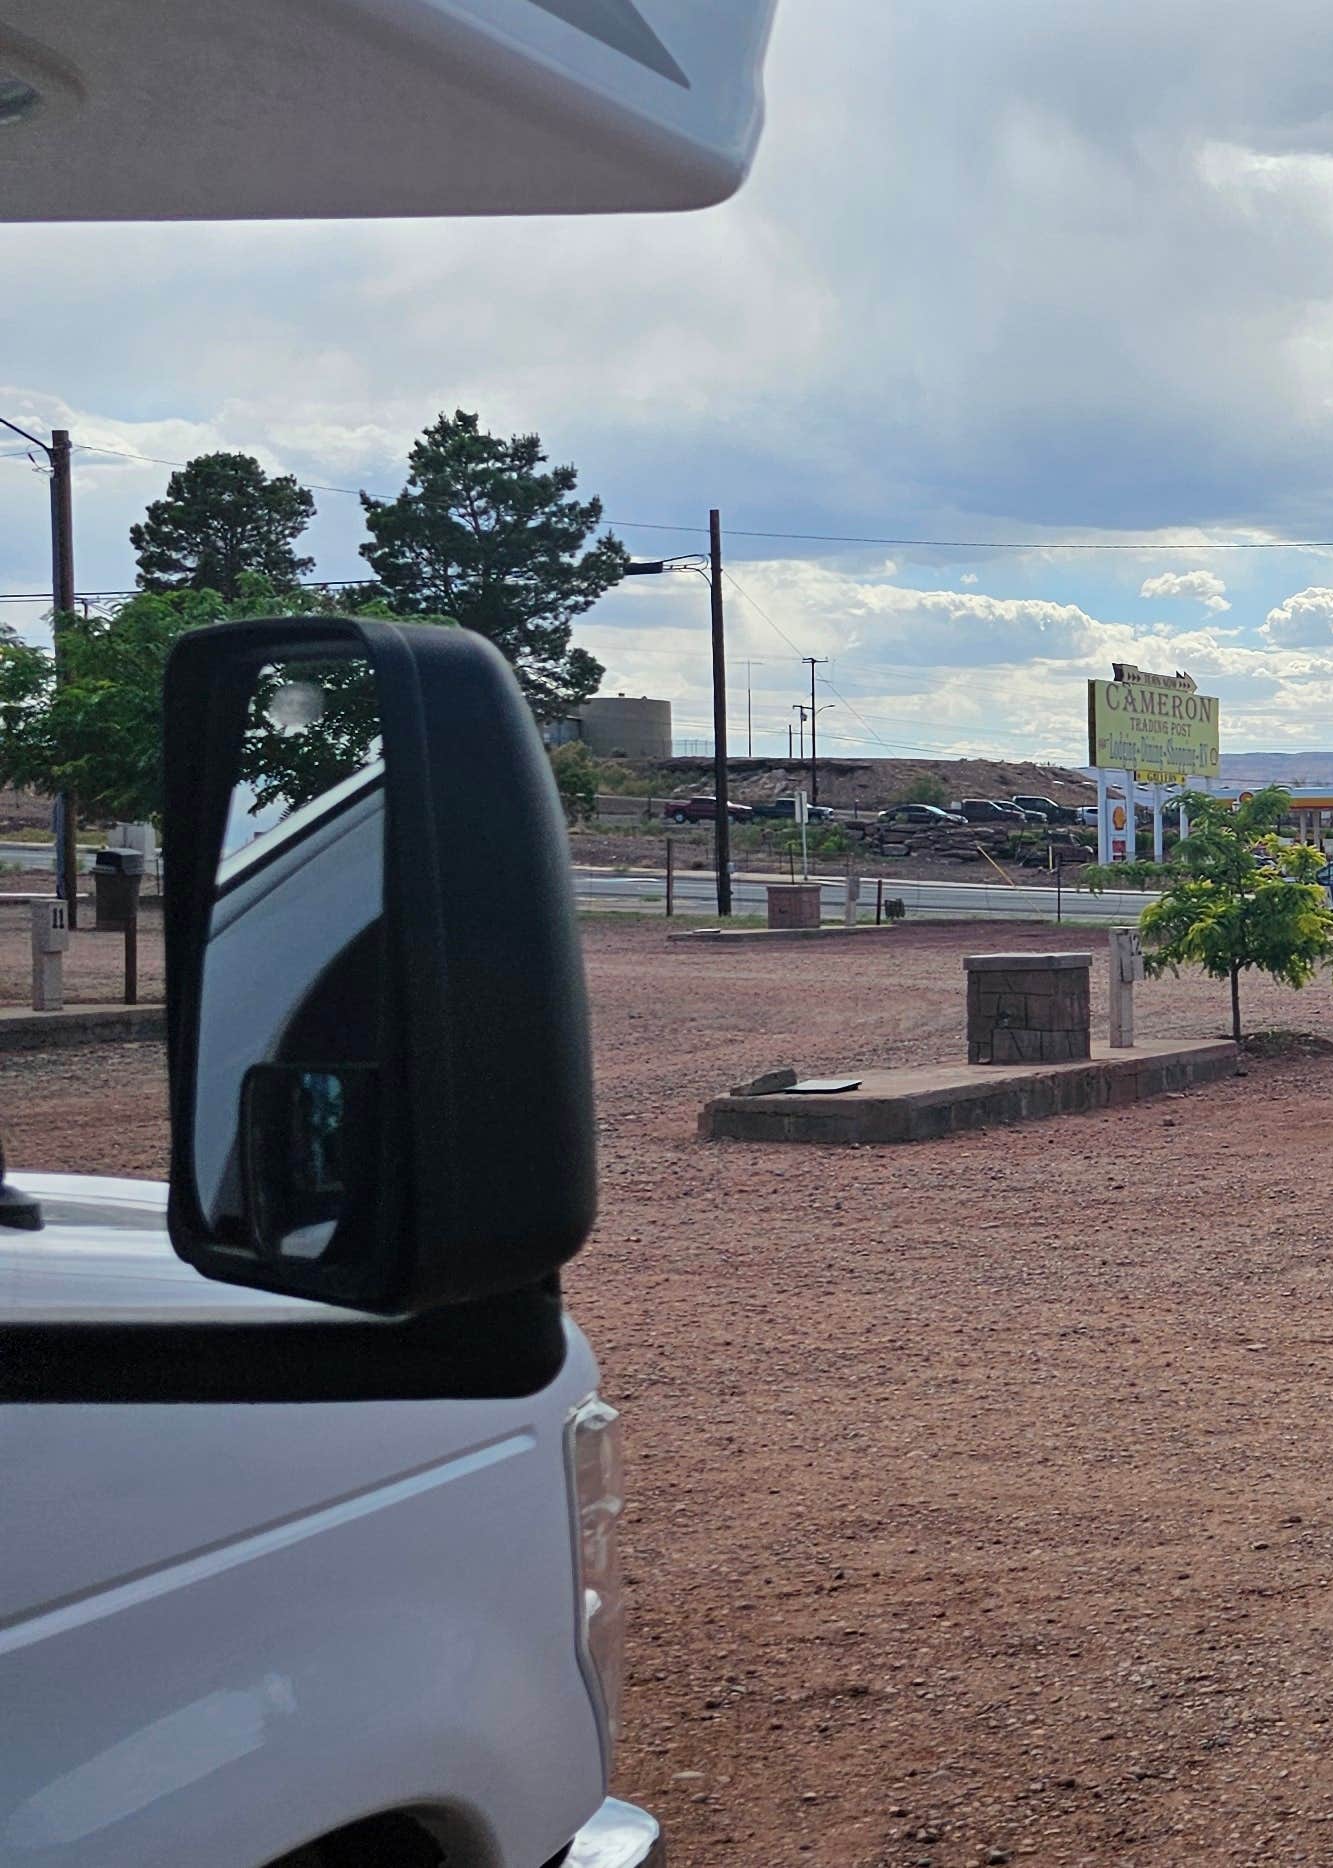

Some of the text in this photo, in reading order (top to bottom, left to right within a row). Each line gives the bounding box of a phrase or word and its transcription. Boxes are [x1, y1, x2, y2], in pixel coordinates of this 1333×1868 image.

[1105, 683, 1212, 724] CAMERON
[1130, 717, 1192, 737] TRADING POST
